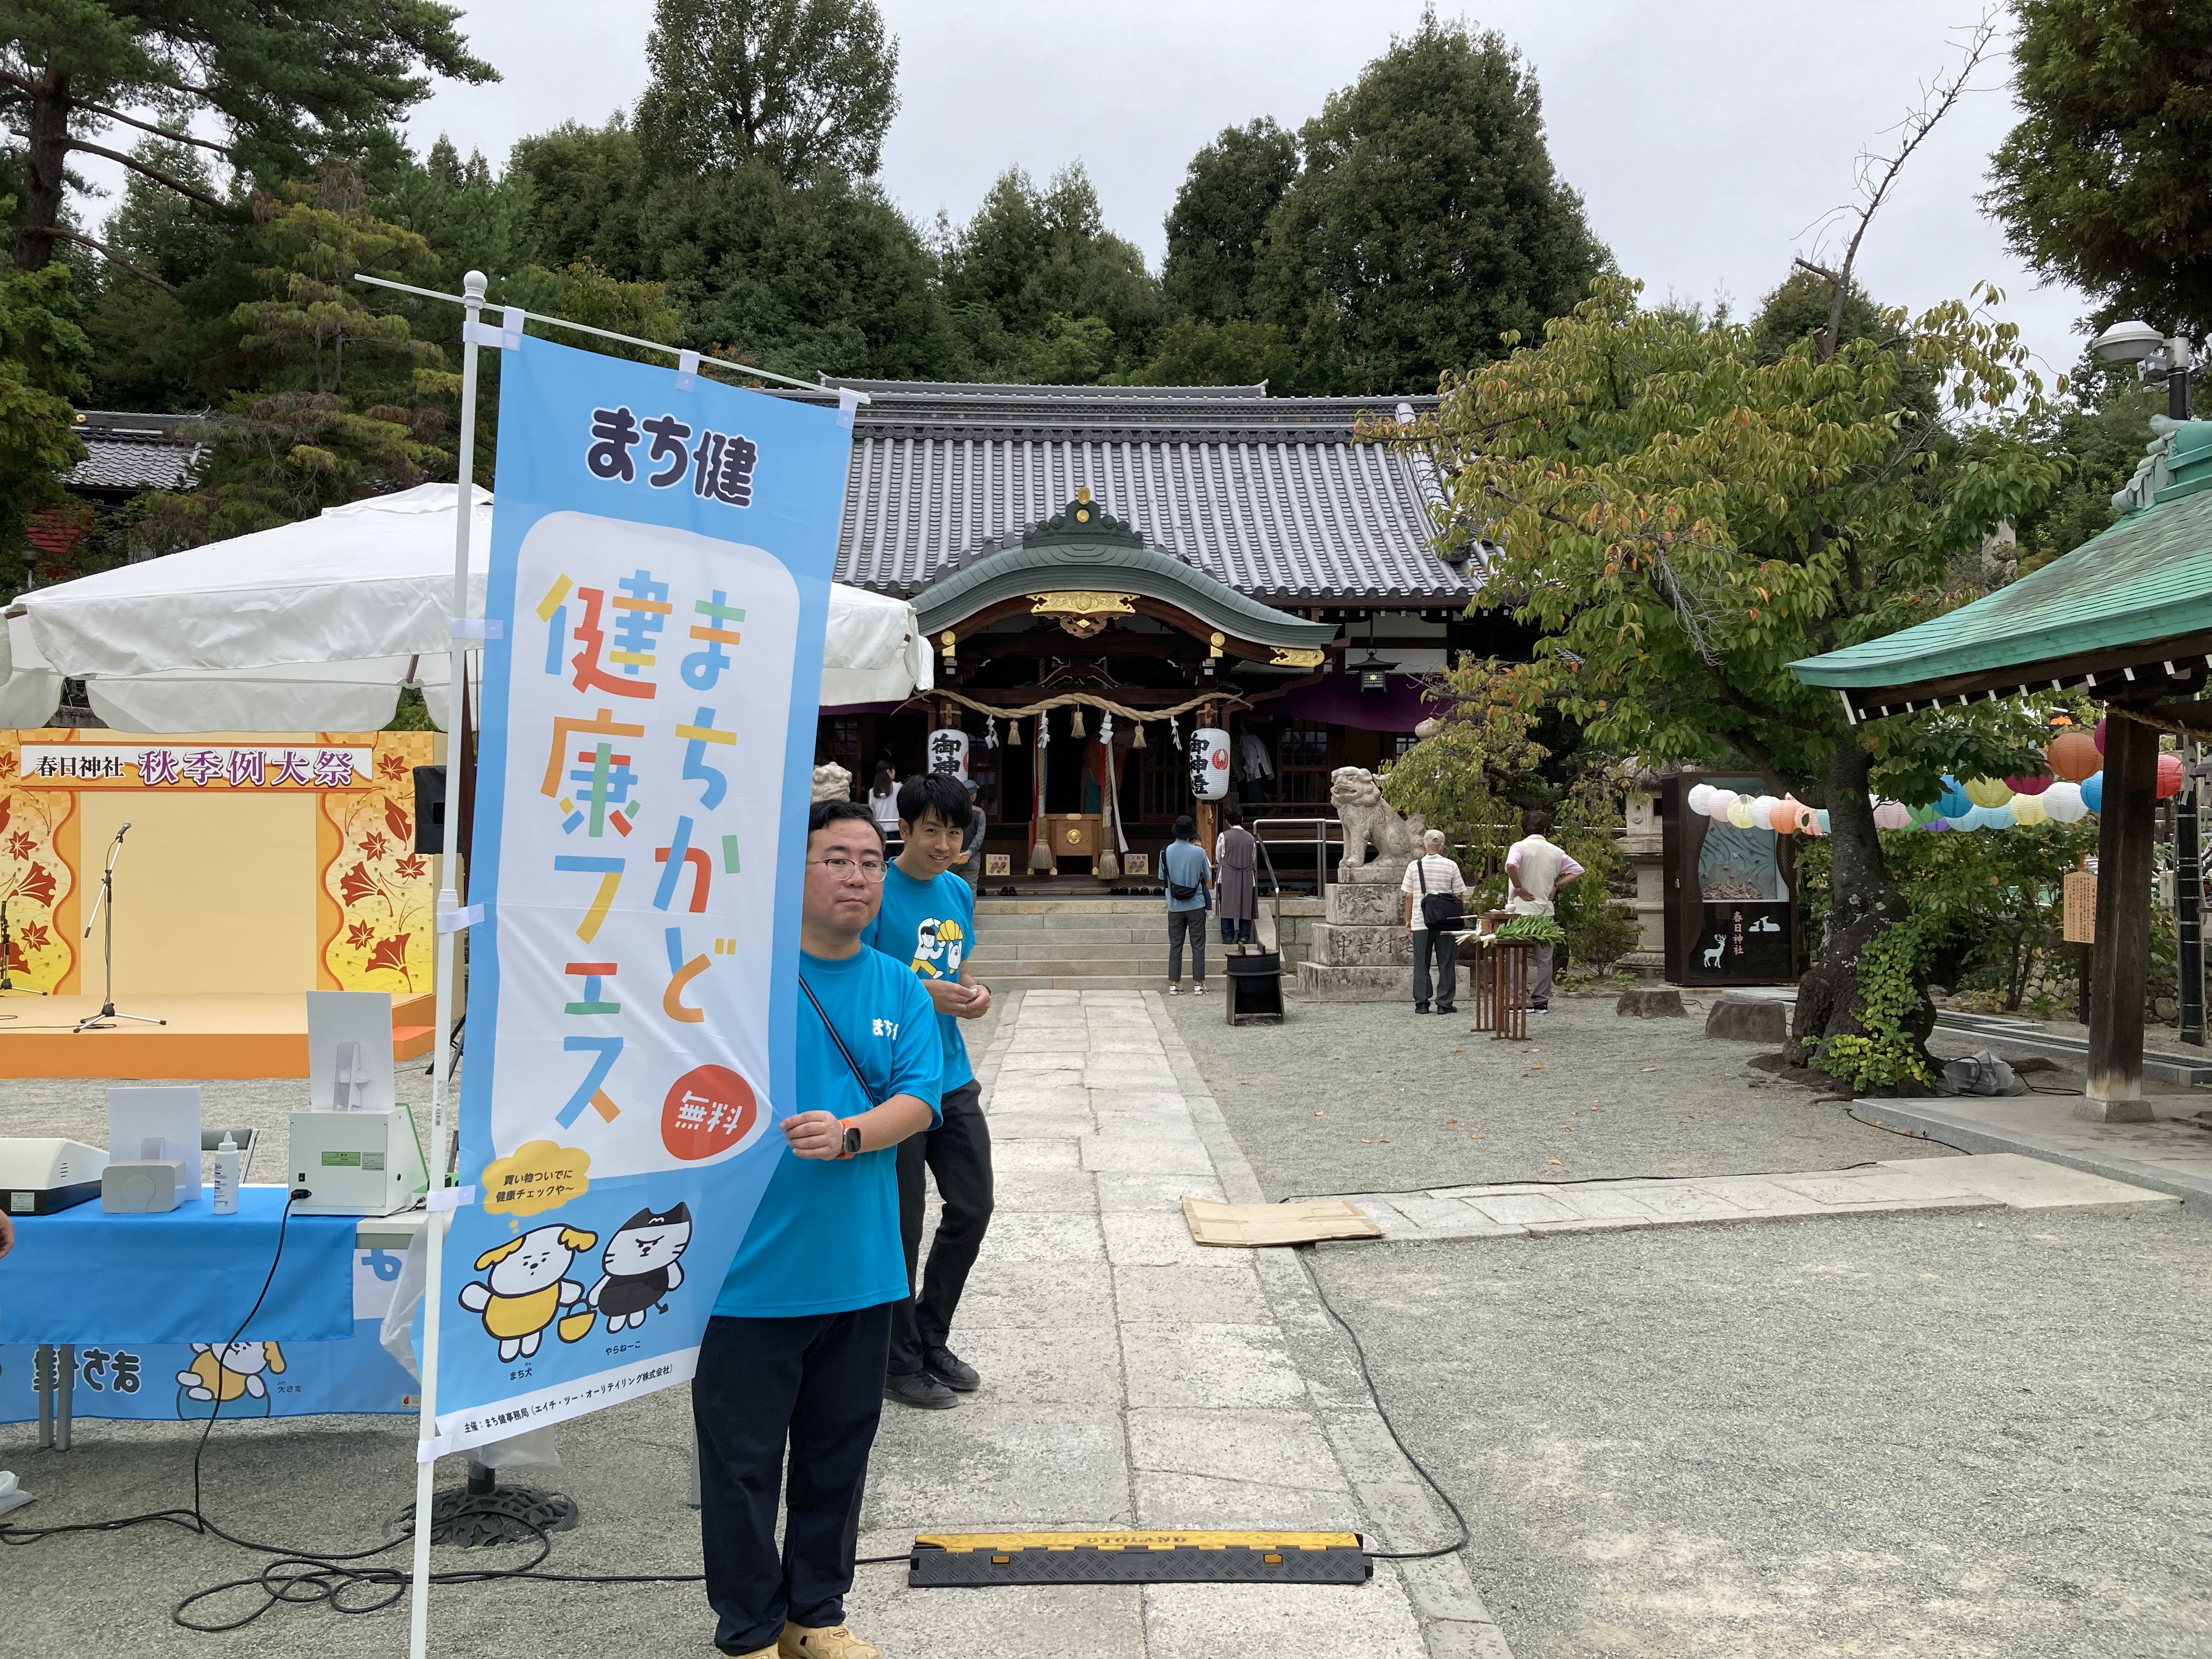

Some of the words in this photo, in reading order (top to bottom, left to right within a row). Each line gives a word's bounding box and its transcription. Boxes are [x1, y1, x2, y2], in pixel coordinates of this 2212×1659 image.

[585, 405, 758, 509] まち健
[35, 755, 125, 779] 春日神社
[138, 748, 354, 787] 秋季例大祭
[652, 590, 746, 1023] まちかど
[536, 569, 673, 1131] 健康フェス
[1733, 911, 1744, 955] 春日神社
[675, 1090, 743, 1135] 無料
[503, 1170, 574, 1186] 買い物ついでに
[605, 1341, 641, 1356] やらねーこ
[510, 1367, 533, 1381] まち犬
